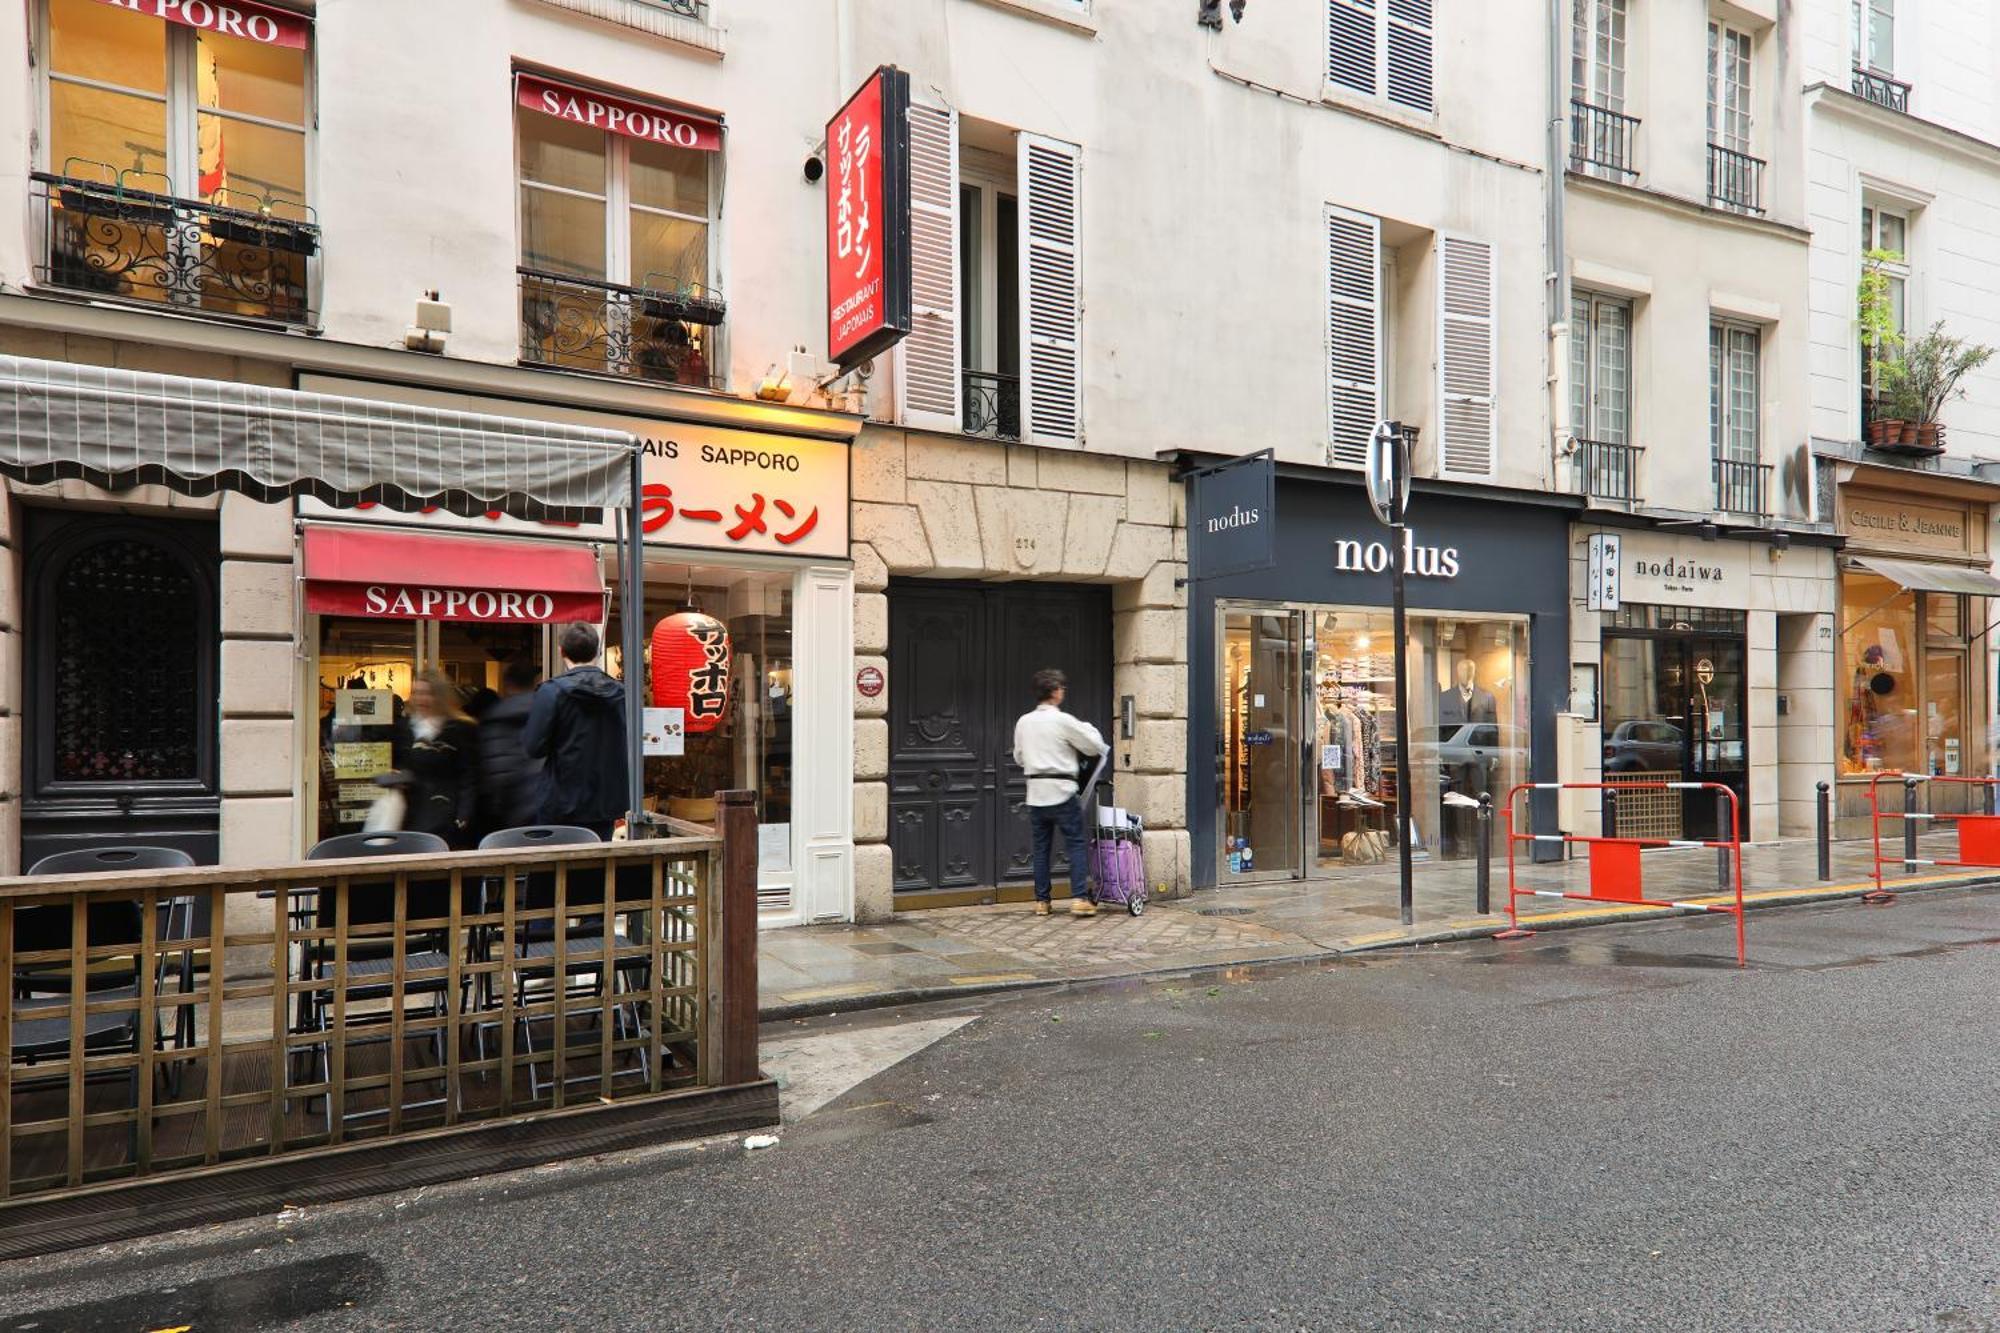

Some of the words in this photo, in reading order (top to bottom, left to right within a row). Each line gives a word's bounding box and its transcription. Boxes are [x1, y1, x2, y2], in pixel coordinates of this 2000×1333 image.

[107, 0, 278, 42] PORO
[542, 90, 698, 146] SAPPORO
[837, 116, 852, 259] サッポロ
[855, 124, 871, 279] ラーメン
[831, 277, 880, 321] RESTAURANT
[837, 303, 874, 341] JAPONAIS
[701, 445, 799, 472] SAPPORO
[642, 483, 818, 545] ラーメン
[1208, 506, 1260, 533] nodus
[1899, 512, 1910, 531] &
[1913, 518, 1960, 538] JEANNE
[366, 586, 554, 619] SAPPORO
